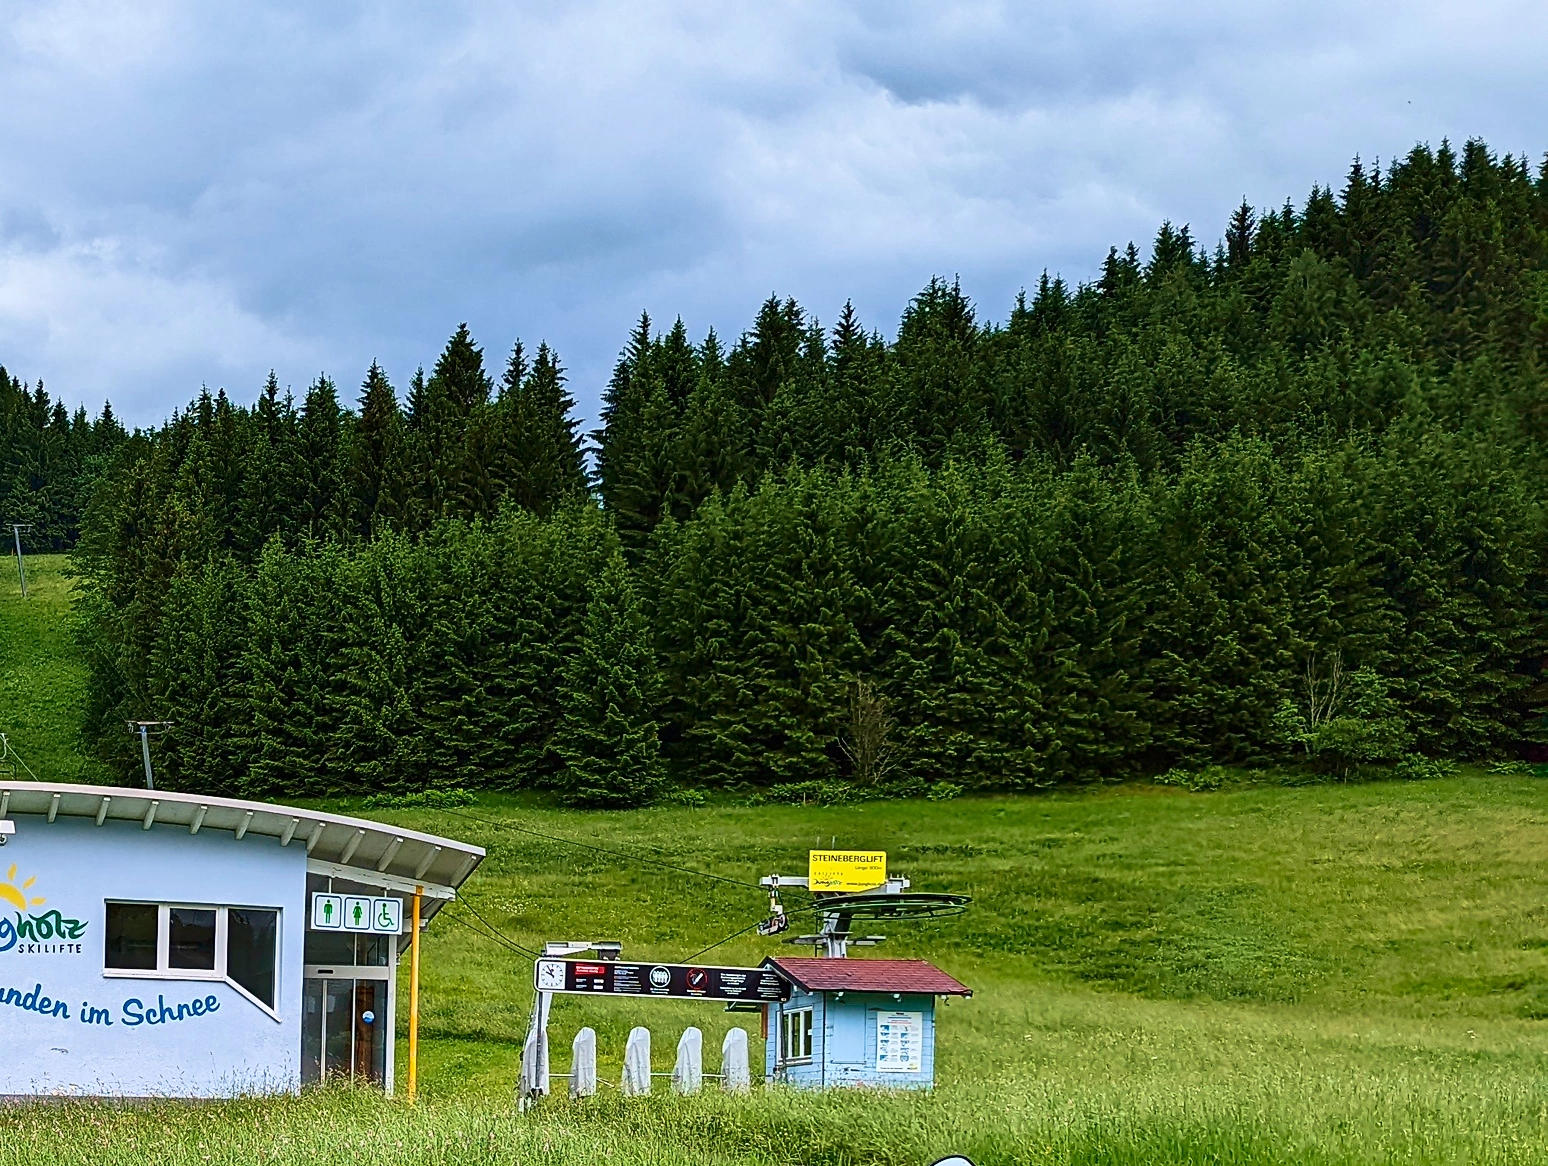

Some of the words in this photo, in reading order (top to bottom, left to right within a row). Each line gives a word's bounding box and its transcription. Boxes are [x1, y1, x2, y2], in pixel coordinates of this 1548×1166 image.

[812, 854, 884, 863] STEINEBERGLIFT
[18, 943, 82, 954] SKILIFTE
[80, 1001, 113, 1026] im
[121, 994, 220, 1026] Schnee
